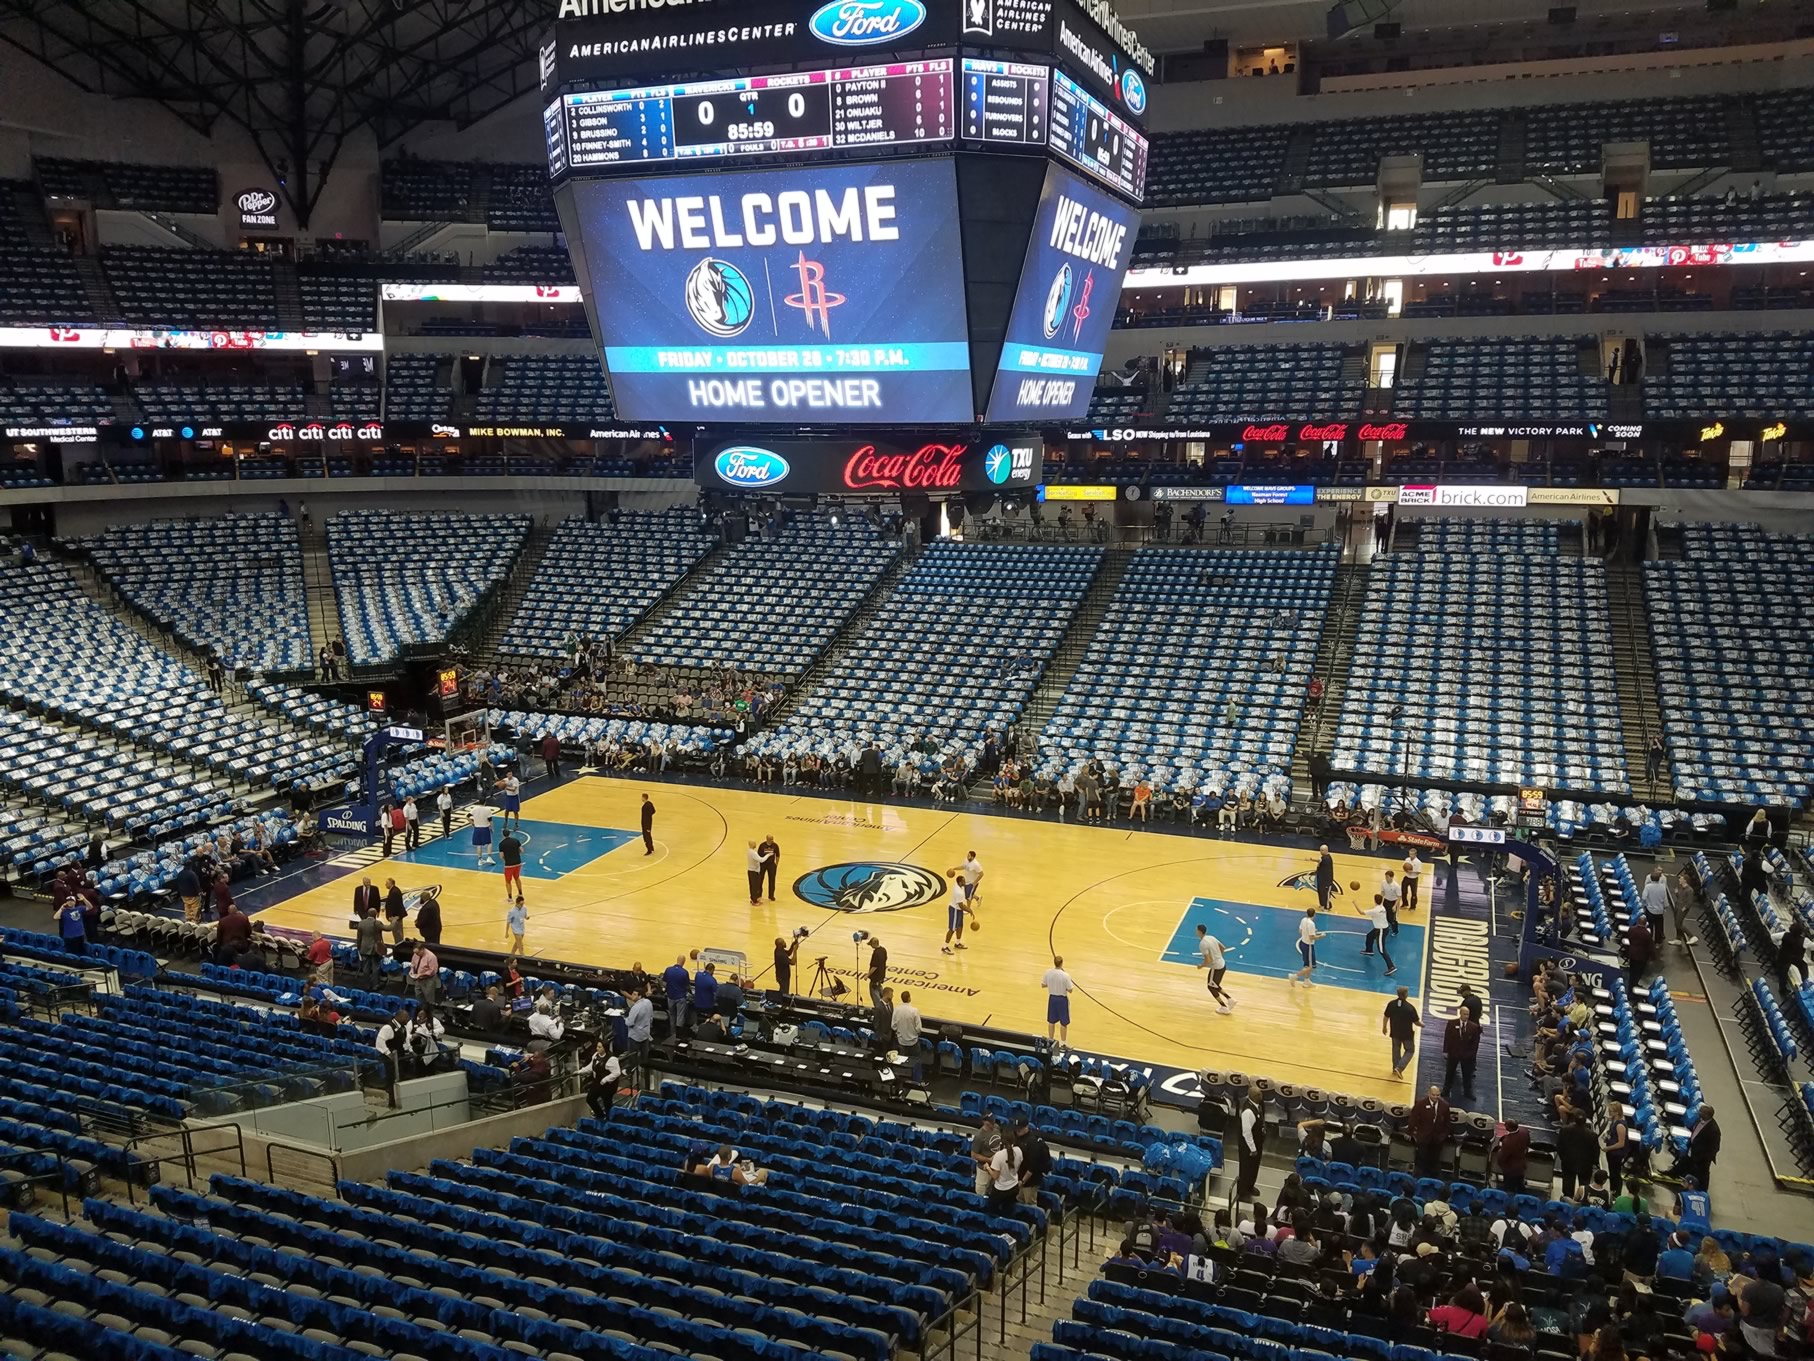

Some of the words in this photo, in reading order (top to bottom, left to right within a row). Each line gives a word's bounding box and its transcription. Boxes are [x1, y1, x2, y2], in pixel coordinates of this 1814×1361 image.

[832, 1, 901, 36] Ford
[996, 9, 1046, 22] AIRLINES
[996, 20, 1038, 33] CENTER
[851, 68, 887, 78] PLAYER
[906, 64, 924, 73] PTS
[929, 61, 947, 71] FLS
[1010, 64, 1045, 77] ROCKETS
[767, 75, 810, 87] ROCKETS
[836, 83, 841, 93] 0
[845, 81, 879, 92] PAYTON
[915, 76, 921, 86] 0
[971, 76, 977, 86] 0
[991, 79, 1017, 89] ASSISTS
[1033, 82, 1040, 91] 0
[739, 91, 758, 102] QTR
[846, 94, 878, 105] BROWN
[971, 92, 977, 101] 0
[987, 95, 1023, 106] REBOUNDS
[1033, 97, 1039, 107] 0
[578, 103, 632, 115] COLLINSWORTH
[698, 101, 714, 125] 0
[747, 103, 754, 115] 1
[788, 93, 805, 118] 0
[835, 109, 845, 118] 21
[847, 106, 882, 117] ONUAKU
[916, 102, 922, 112] 0
[579, 117, 607, 127] GIBSON
[835, 122, 845, 131] 30
[847, 119, 883, 130] WILTJER
[939, 113, 945, 123] 0
[970, 110, 976, 119] 0
[985, 112, 1023, 123] TURNOVERS
[1032, 115, 1039, 124] 0
[580, 128, 618, 139] BRUSSINO
[660, 124, 666, 133] 0
[728, 121, 774, 140] 85:59
[836, 134, 846, 144] 32
[847, 131, 895, 143] MCDANIELS
[914, 128, 925, 138] 10
[939, 126, 945, 136] 0
[969, 125, 976, 134] 0
[992, 128, 1017, 138] BLOCKS
[1032, 130, 1039, 139] 0
[572, 142, 581, 151] 10
[581, 139, 631, 150] FINNEY-SMITH
[661, 136, 667, 145] 0
[740, 144, 765, 152] FOULS
[573, 153, 582, 163] 20
[582, 151, 619, 162] HAMMONS
[662, 148, 668, 157] 0
[238, 194, 273, 211] Pepper
[242, 214, 257, 223] FAN
[257, 215, 276, 224] ZONE
[626, 184, 900, 250] WELCOME
[1050, 194, 1127, 270] WELCOME
[658, 351, 712, 368] FRIDAY
[726, 350, 799, 368] OCTOBER
[836, 350, 870, 367] 7:30
[875, 349, 910, 366] P.M.
[688, 379, 765, 407] HOME
[771, 378, 882, 407] OPENER
[1017, 379, 1045, 405] HOME
[1043, 379, 1075, 405] OPENER
[6, 428, 19, 437] UT
[20, 427, 97, 437] SOUTHWESTERN
[152, 429, 174, 437] AT&T
[202, 428, 222, 436] AT&T
[268, 425, 293, 440] citi
[299, 425, 323, 440] citi
[328, 425, 352, 440] citi
[357, 425, 382, 439] citi
[469, 428, 494, 437] MIKE
[496, 428, 544, 438] BOWMAN,
[546, 428, 565, 437] INC.
[590, 430, 628, 438] American
[1103, 429, 1135, 440] LSO
[1149, 431, 1169, 440] Shipping
[1187, 430, 1210, 438] Louisiana
[1480, 427, 1505, 435] NEW
[1508, 427, 1553, 435] VICTORY
[1556, 427, 1583, 435] PARK
[1011, 448, 1033, 468] TXU
[726, 453, 770, 480] Ford
[844, 444, 968, 488] Coca-Cola
[1011, 468, 1031, 480] energy
[1167, 488, 1222, 496] BACHENDORF'S
[1441, 490, 1524, 505] brick.com
[1531, 491, 1569, 501] American
[1569, 491, 1601, 502] Airlines
[327, 817, 367, 833] SPALDING
[886, 965, 940, 981] Cente
[1207, 1073, 1218, 1083] G
[1230, 1074, 1241, 1084] G
[1256, 1079, 1268, 1089] G
[1281, 1085, 1293, 1096] G
[1307, 1090, 1319, 1101] G
[1335, 1096, 1347, 1106] G
[1362, 1100, 1375, 1111] G
[1391, 1106, 1403, 1116] G
[1474, 1118, 1486, 1129] G
